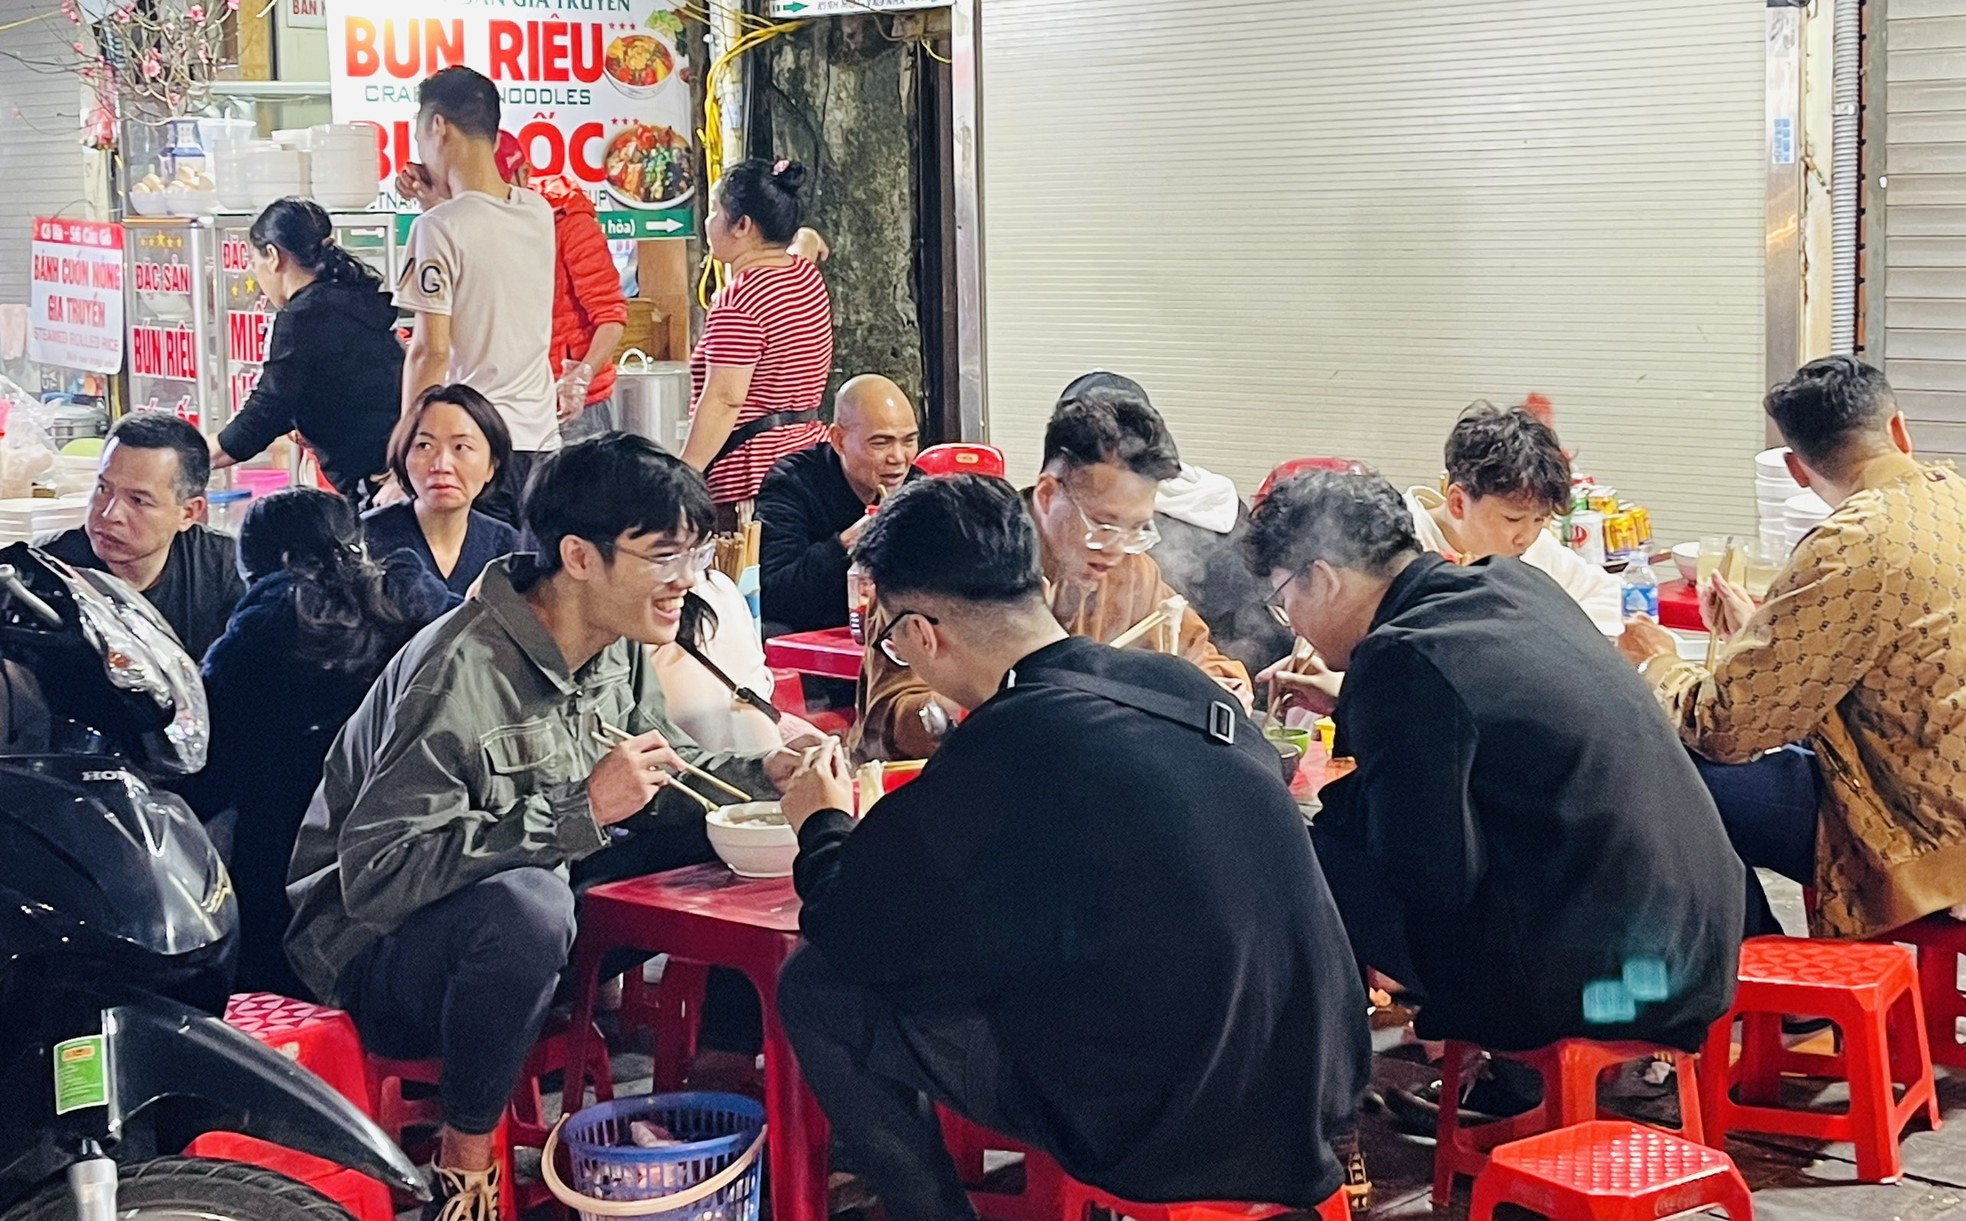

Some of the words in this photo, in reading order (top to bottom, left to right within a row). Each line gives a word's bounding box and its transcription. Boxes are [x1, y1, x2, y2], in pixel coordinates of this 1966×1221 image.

[489, 13, 605, 83] RIÊU
[133, 319, 162, 376] BÚN
[165, 320, 197, 380] RIÊU
